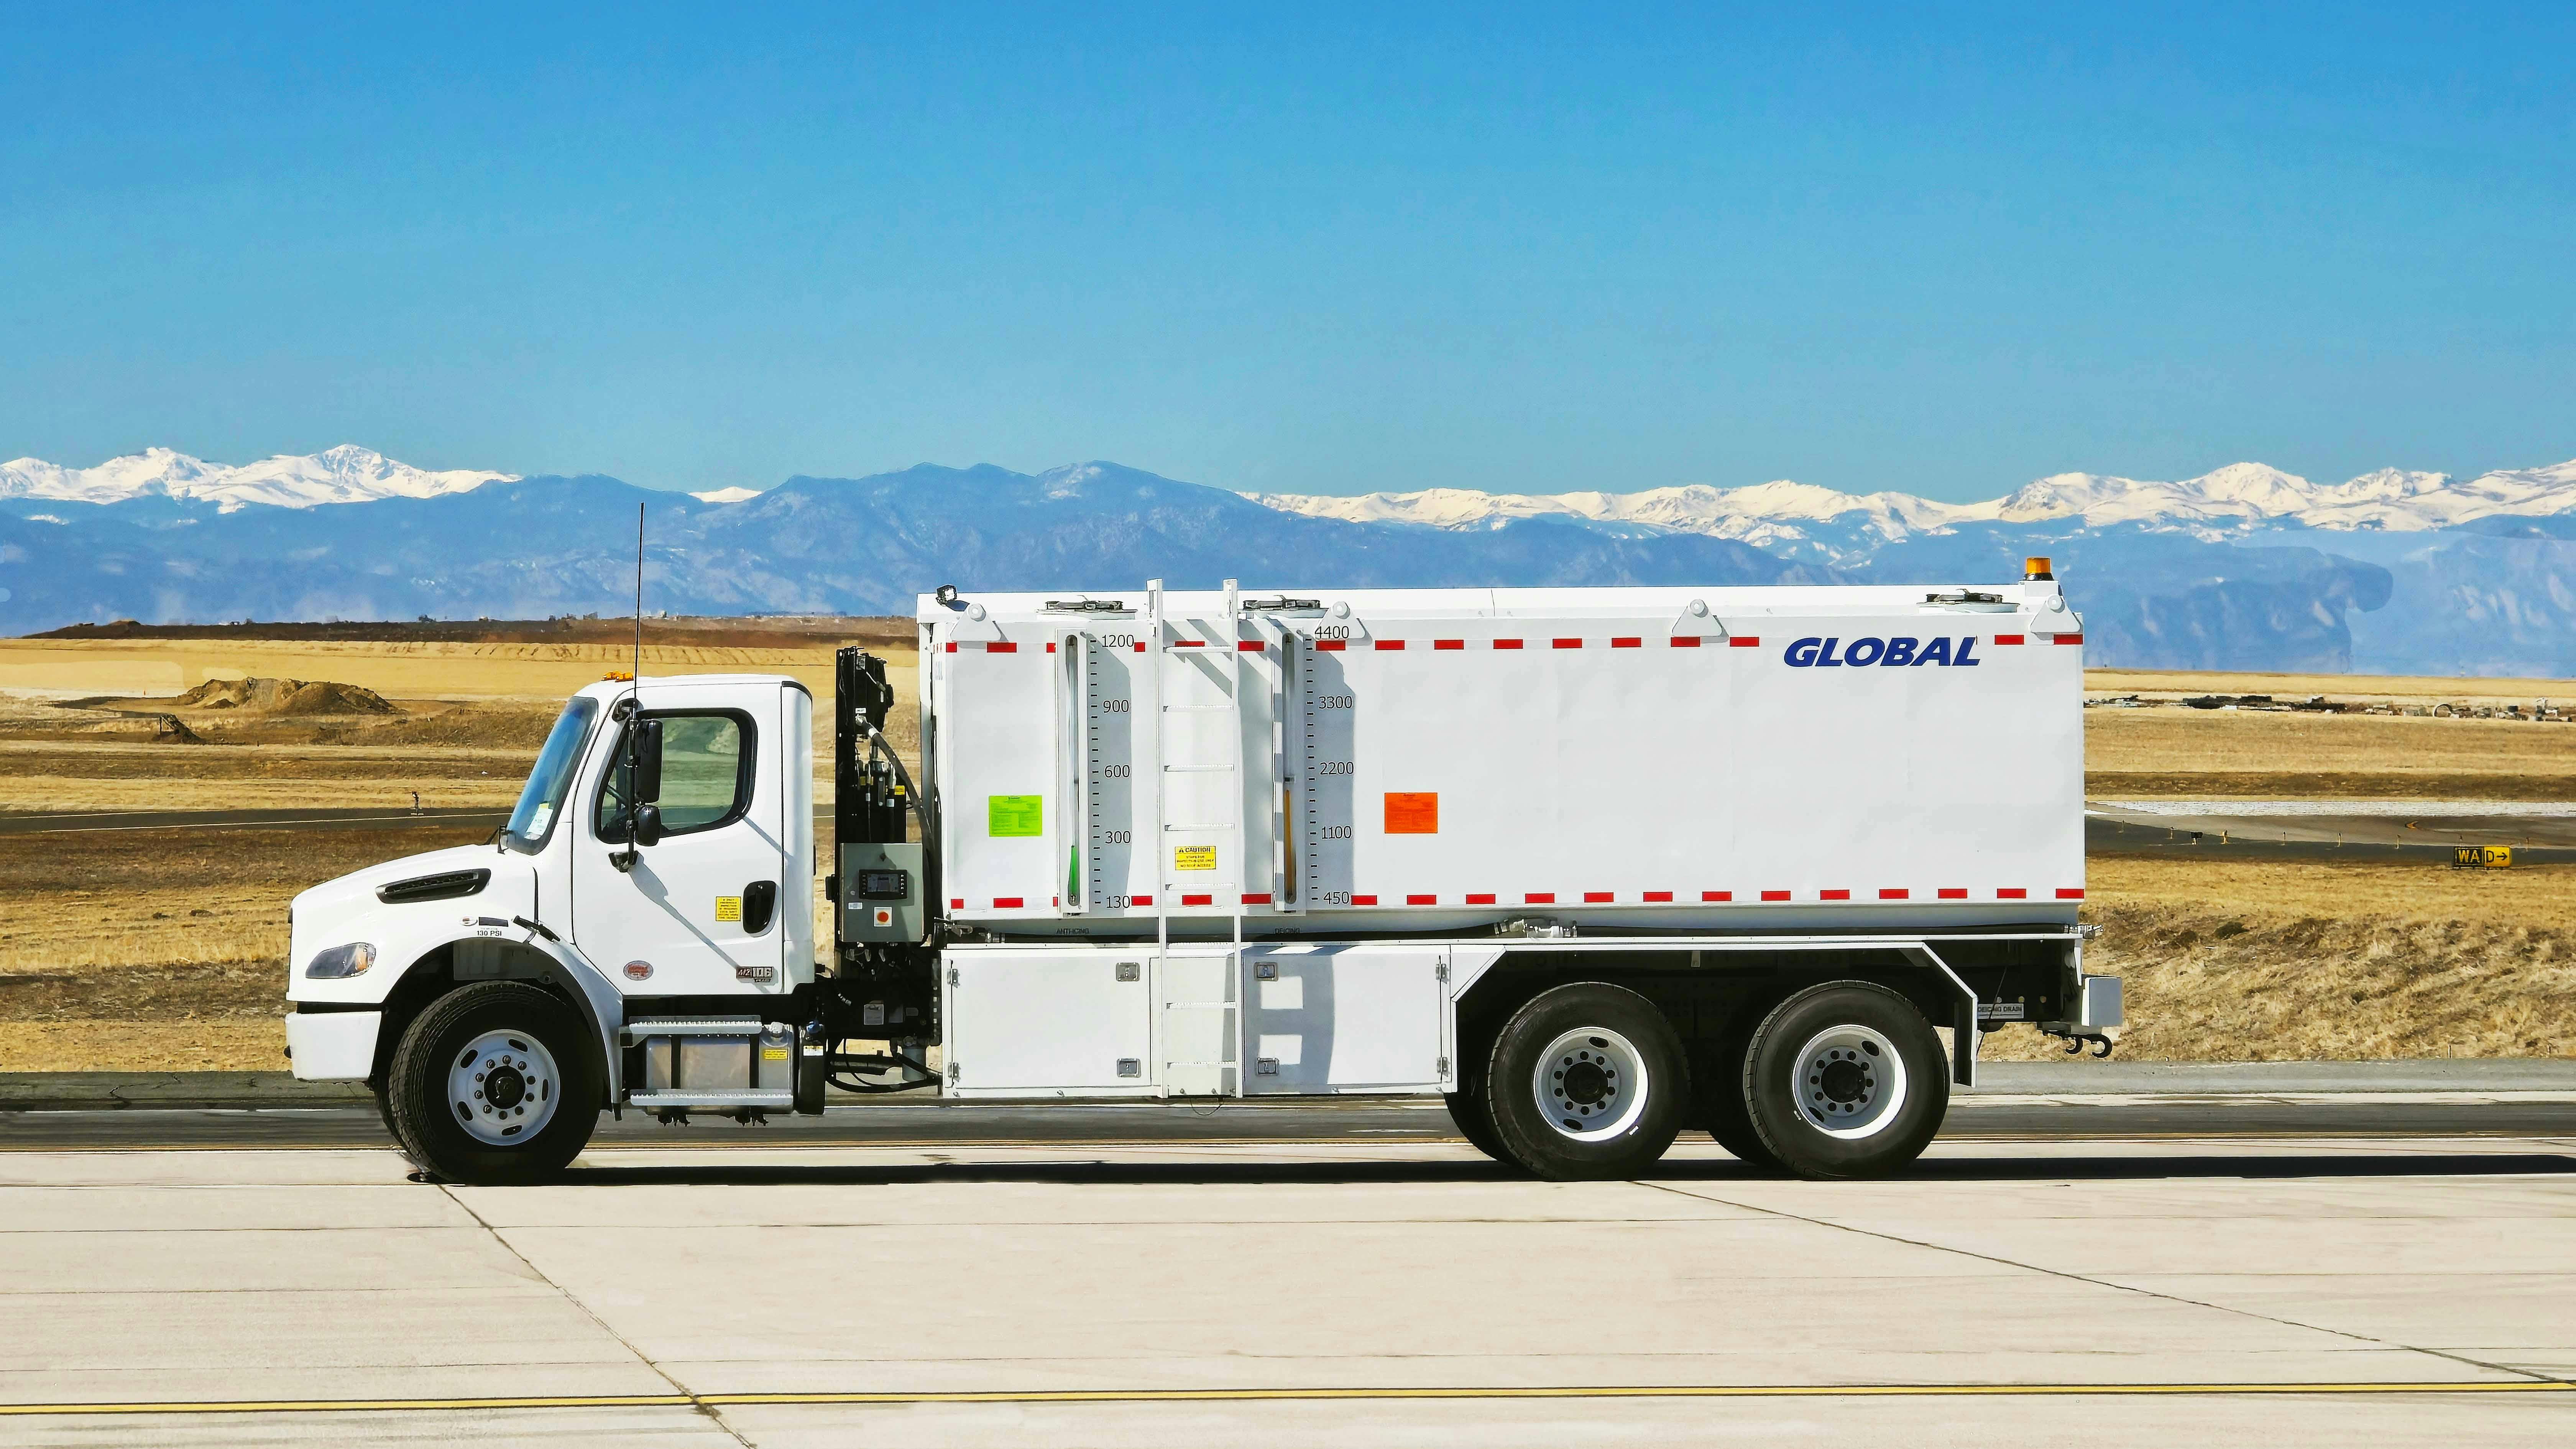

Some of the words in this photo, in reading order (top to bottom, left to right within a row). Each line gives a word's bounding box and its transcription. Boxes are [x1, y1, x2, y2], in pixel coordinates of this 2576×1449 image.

[1314, 626, 1349, 639] 4400
[1102, 634, 1134, 647] 1200
[1784, 637, 1980, 667] GLOBAL
[1103, 700, 1129, 713] 900
[1319, 696, 1352, 709] 3300
[1104, 765, 1130, 778] 600
[1320, 761, 1354, 775] 2200
[1105, 831, 1131, 844] 300
[1321, 826, 1352, 839] 1100
[2458, 849, 2480, 863] WA
[2486, 850, 2494, 863] D
[1106, 895, 1130, 909] 130
[1323, 891, 1349, 905] 450
[752, 967, 772, 977] 106
